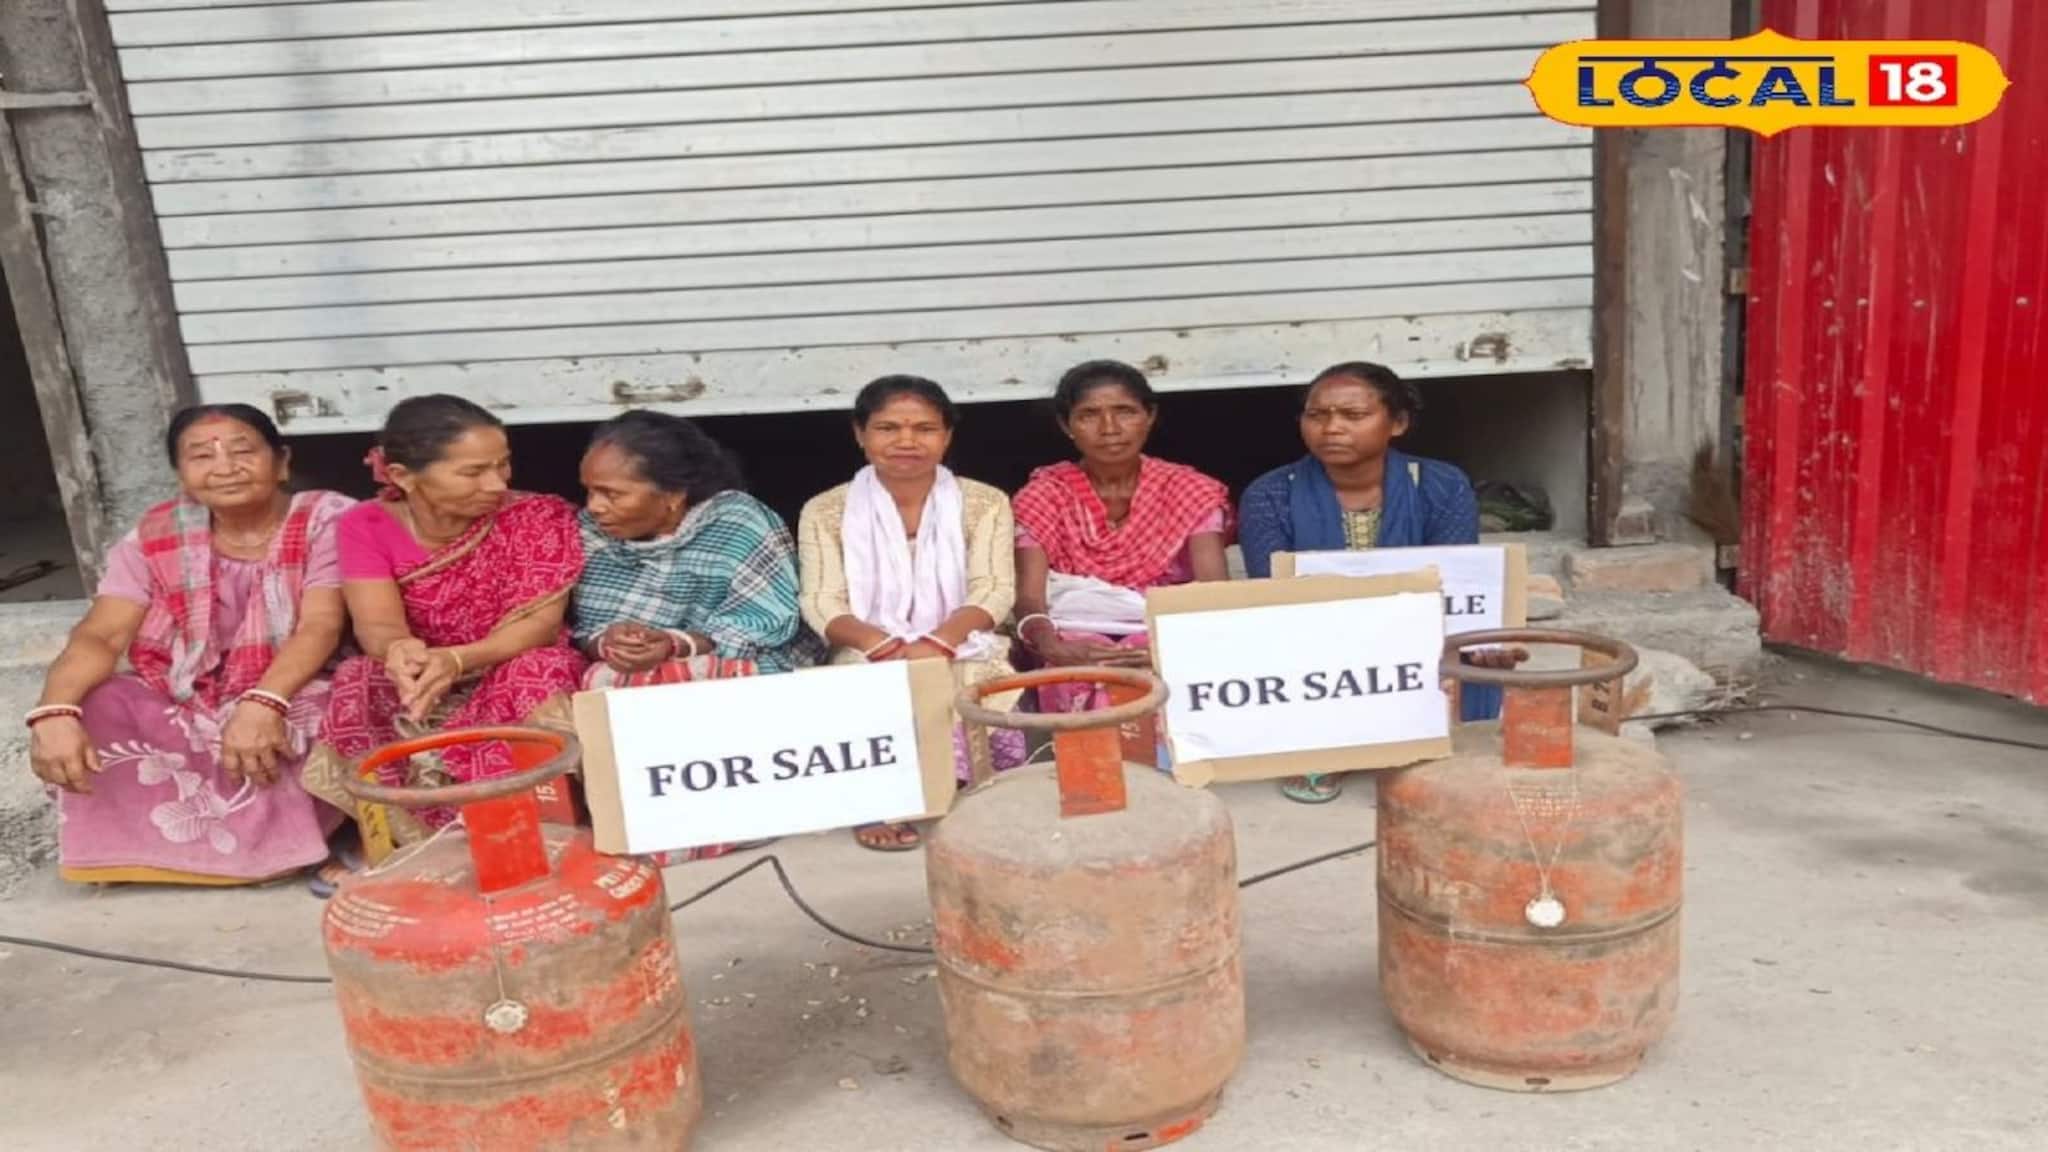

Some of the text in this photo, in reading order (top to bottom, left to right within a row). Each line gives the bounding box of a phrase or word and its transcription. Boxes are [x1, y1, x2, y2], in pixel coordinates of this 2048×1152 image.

[1444, 594, 1486, 616] LE
[1187, 662, 1424, 712] FOR SALE
[646, 735, 898, 797] FOR SALE
